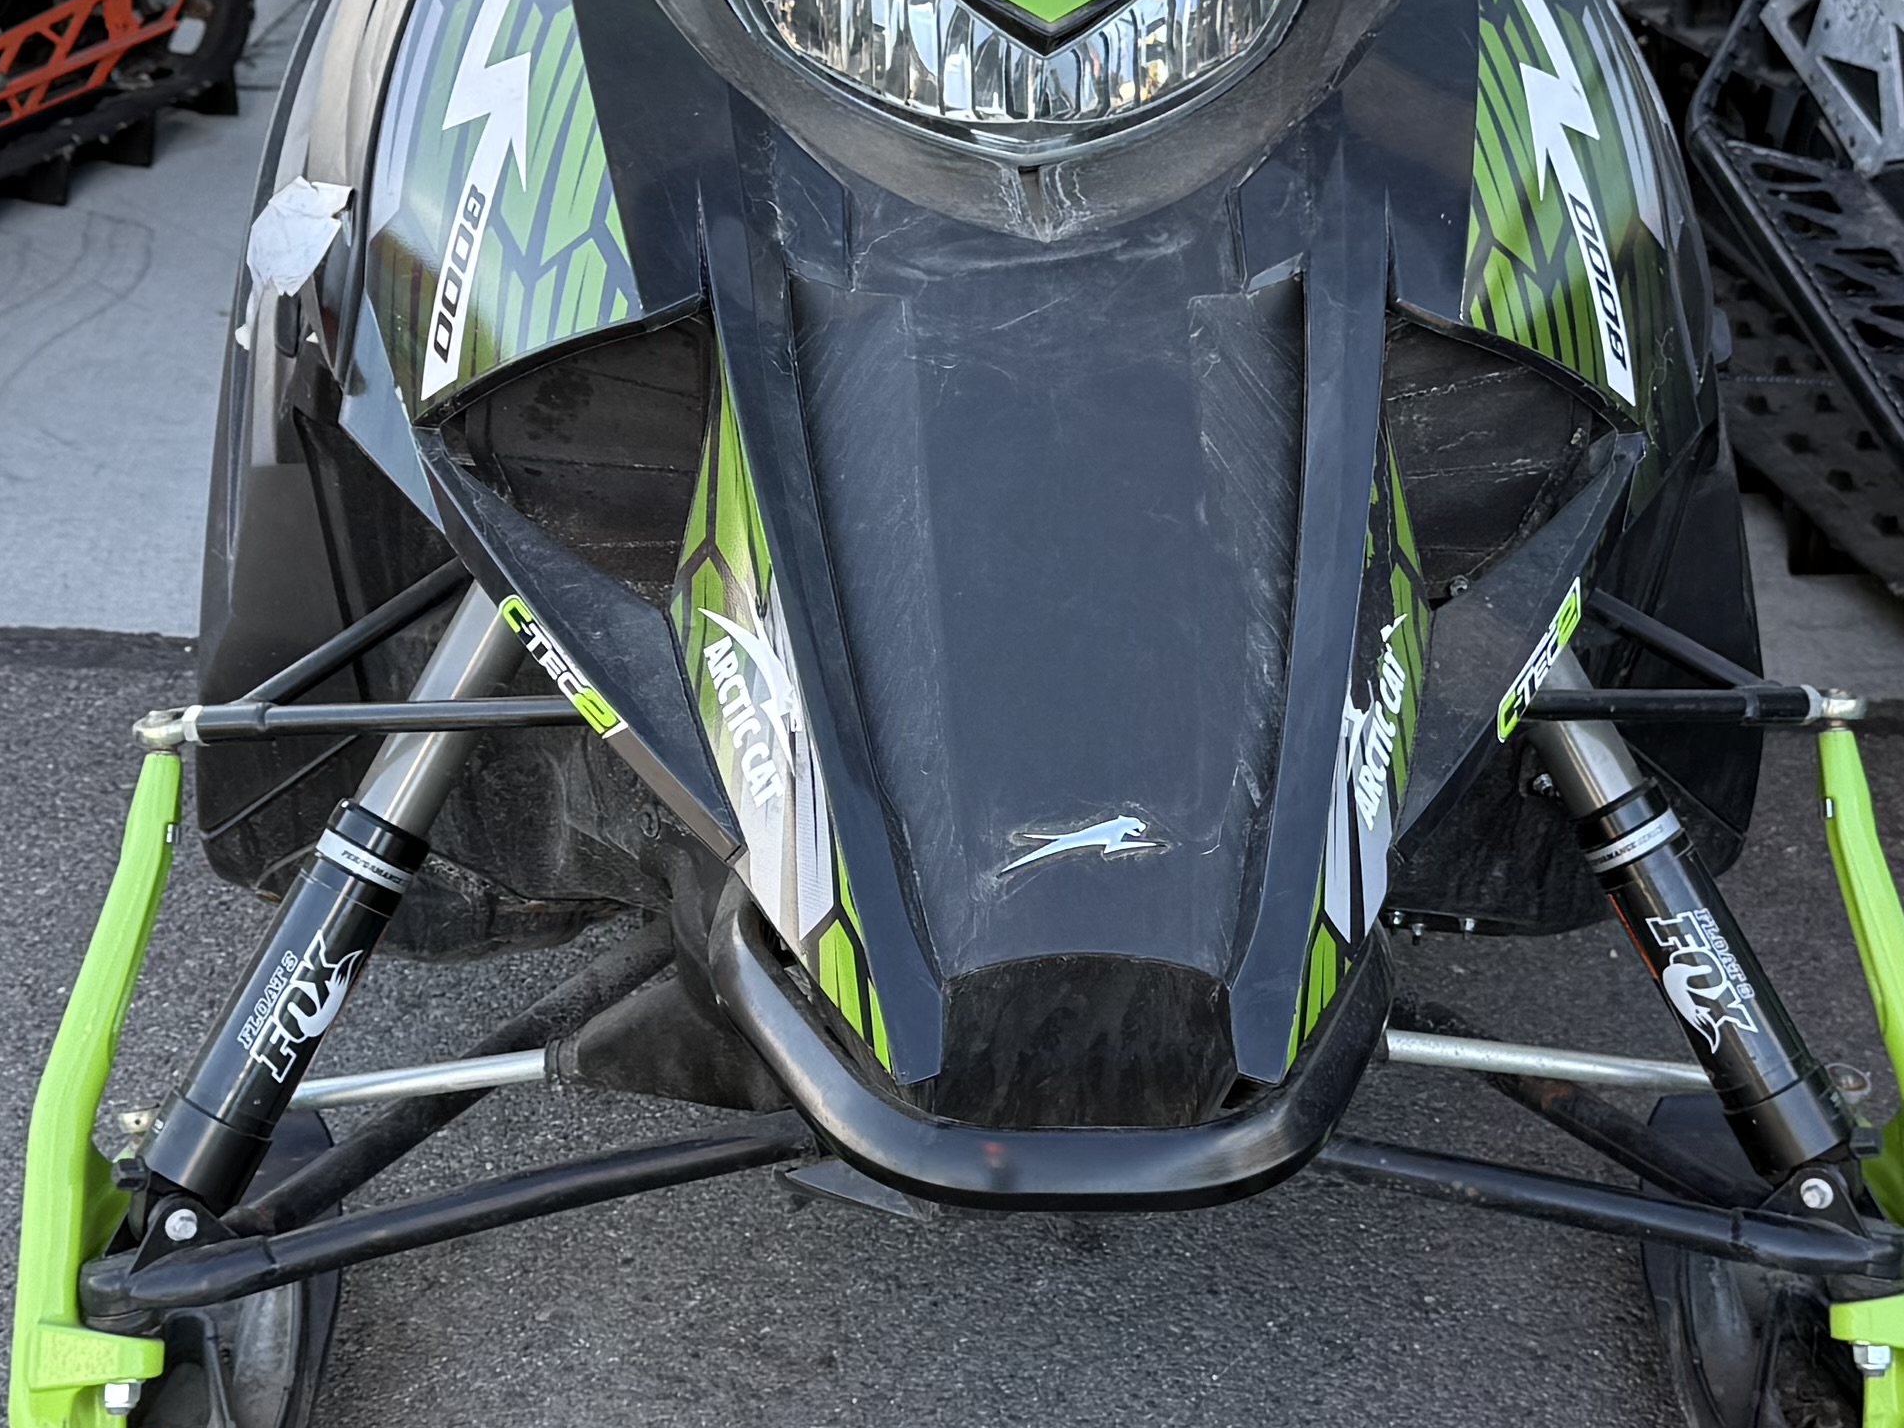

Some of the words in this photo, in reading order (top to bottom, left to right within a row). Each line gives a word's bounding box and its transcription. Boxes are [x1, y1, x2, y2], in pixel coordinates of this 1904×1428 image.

[433, 184, 486, 363] 8000
[1568, 192, 1627, 371] 8000
[500, 596, 620, 735] C-TEC2
[703, 635, 761, 749] ARCTIC
[741, 741, 786, 809] CAT
[1498, 588, 1581, 741] C-TEC2
[1355, 700, 1396, 831] ARCTIC
[237, 967, 291, 1051] FLOAT
[249, 929, 358, 1084] FOX
[1645, 911, 1759, 1047] FOX
[1693, 908, 1747, 983] FLOAT
